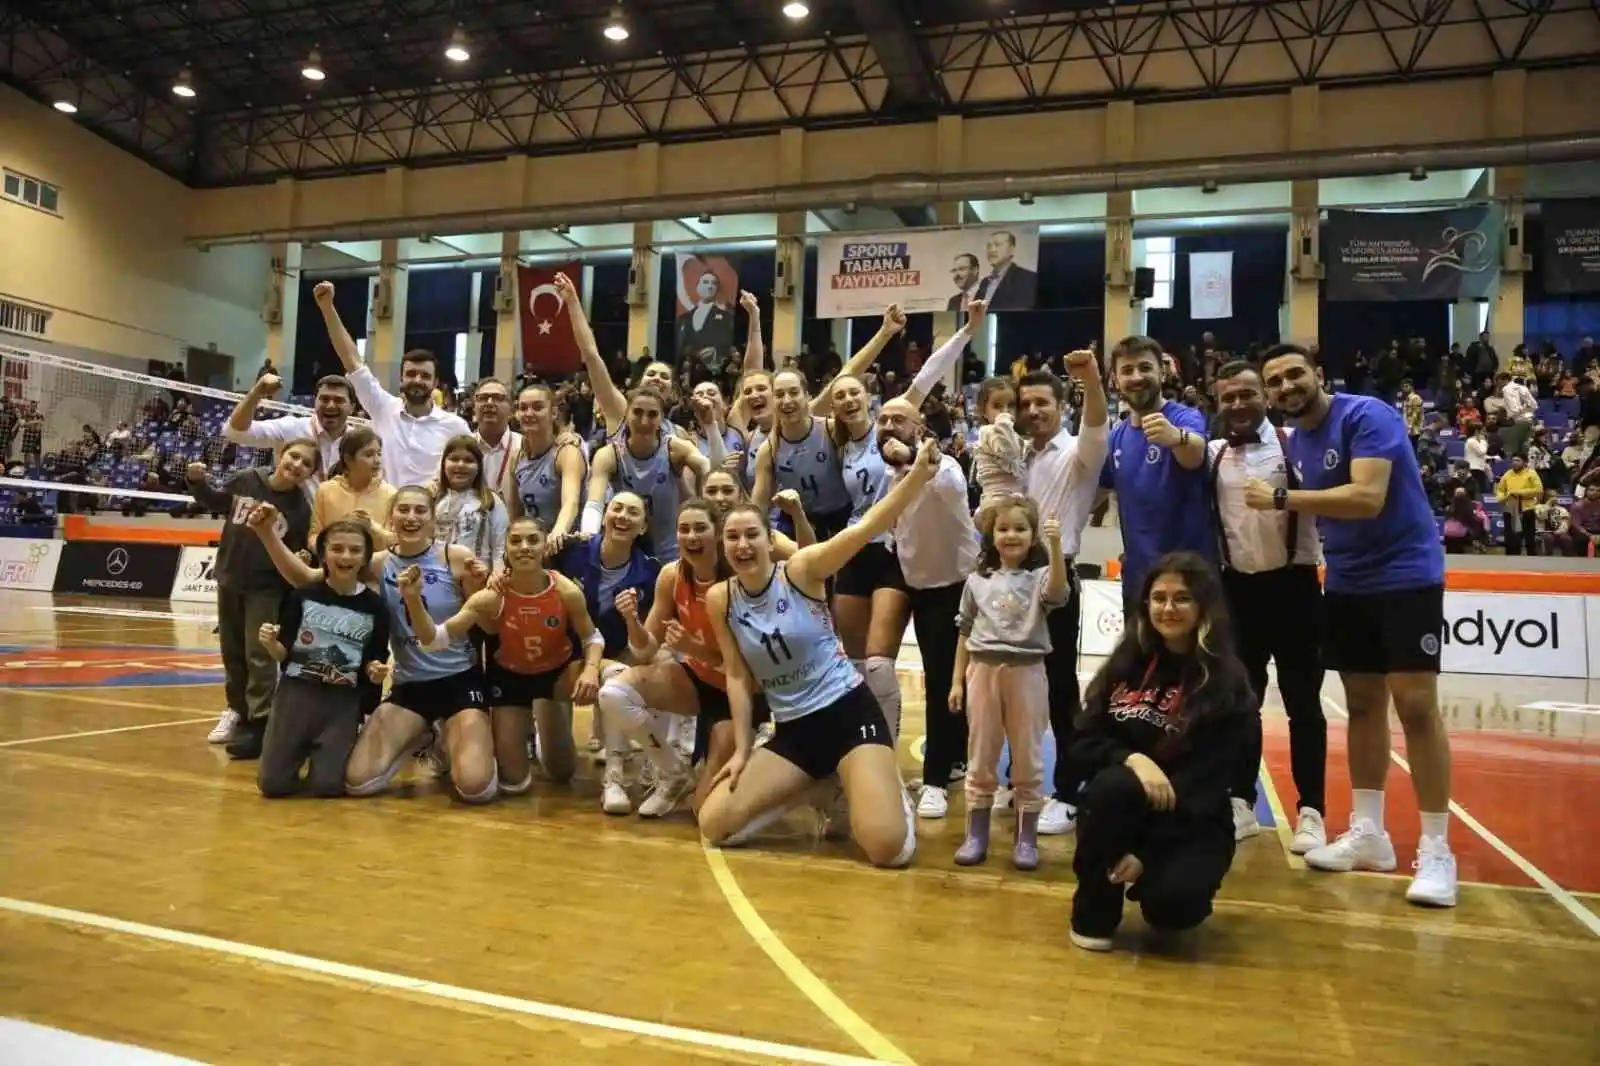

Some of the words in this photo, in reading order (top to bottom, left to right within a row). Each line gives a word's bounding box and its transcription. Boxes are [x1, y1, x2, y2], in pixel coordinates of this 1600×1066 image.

[847, 243, 899, 257] SPORU
[843, 257, 904, 273] TABANA
[834, 272, 918, 288] YAYIYORUZ
[800, 474, 819, 497] 4
[856, 467, 875, 495] 2
[523, 635, 543, 662] 5
[760, 627, 793, 665] 11
[860, 723, 877, 739] 11
